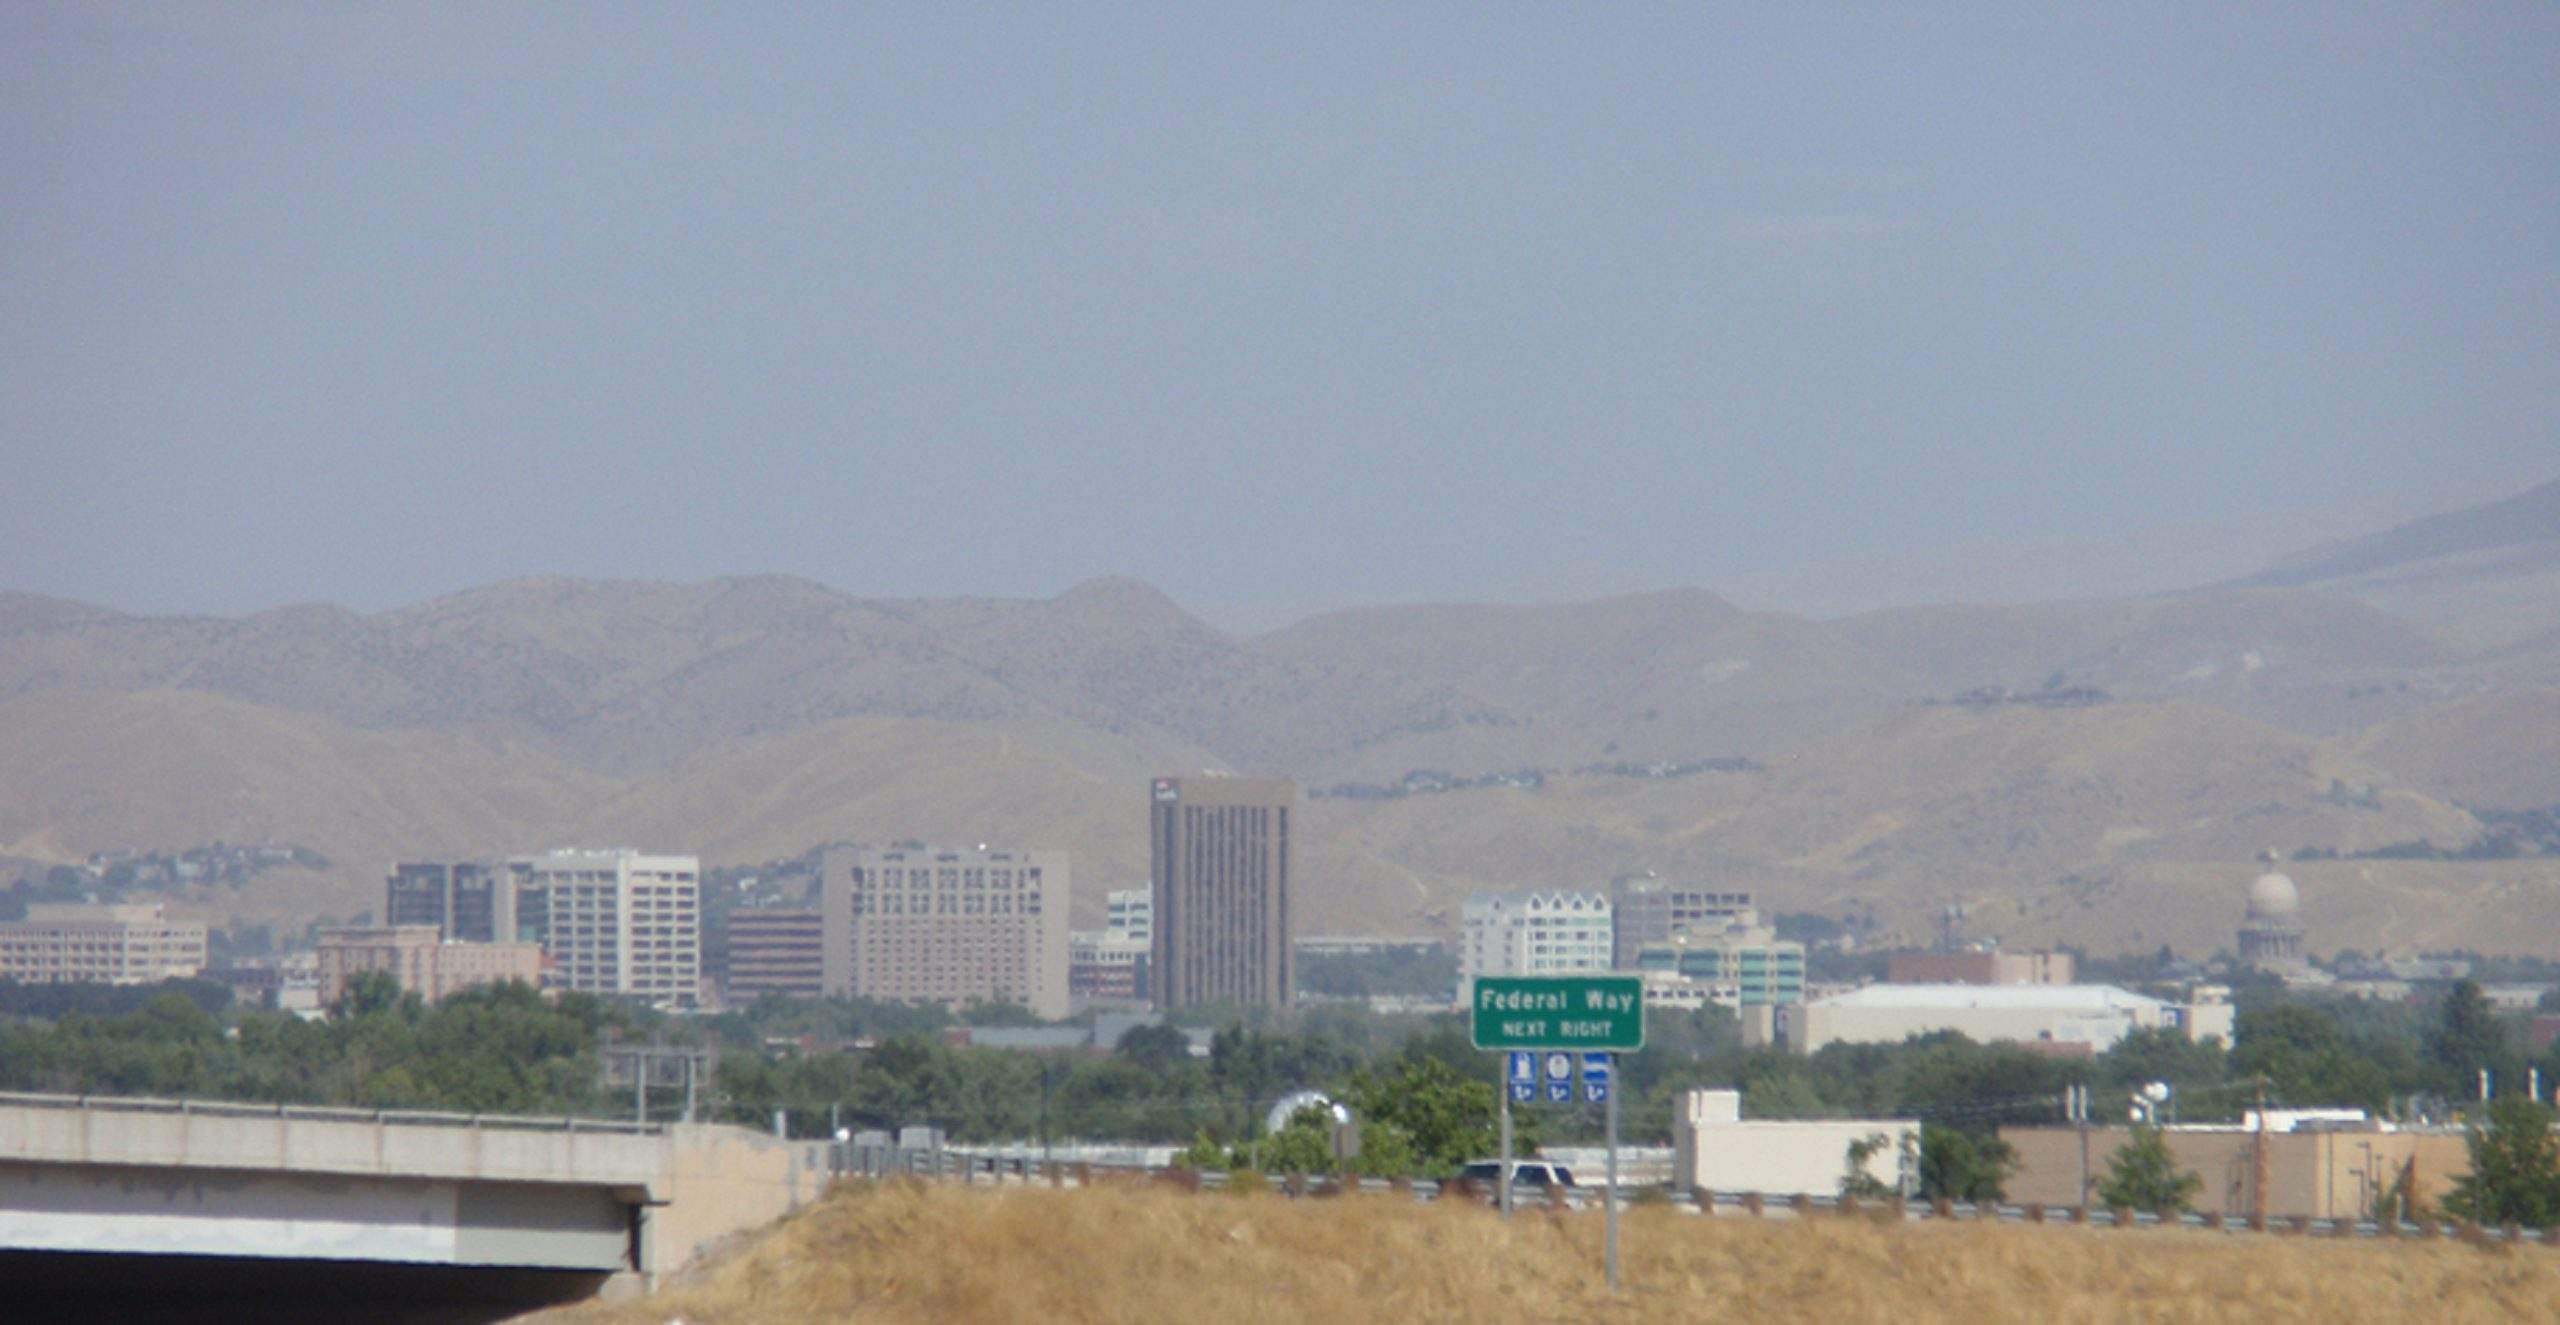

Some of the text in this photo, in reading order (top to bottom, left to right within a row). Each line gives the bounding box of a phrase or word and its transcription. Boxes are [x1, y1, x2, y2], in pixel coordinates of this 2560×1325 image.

[1481, 989, 1634, 1014] Federal Way
[1503, 1021, 1612, 1037] NEXT RIGHT
